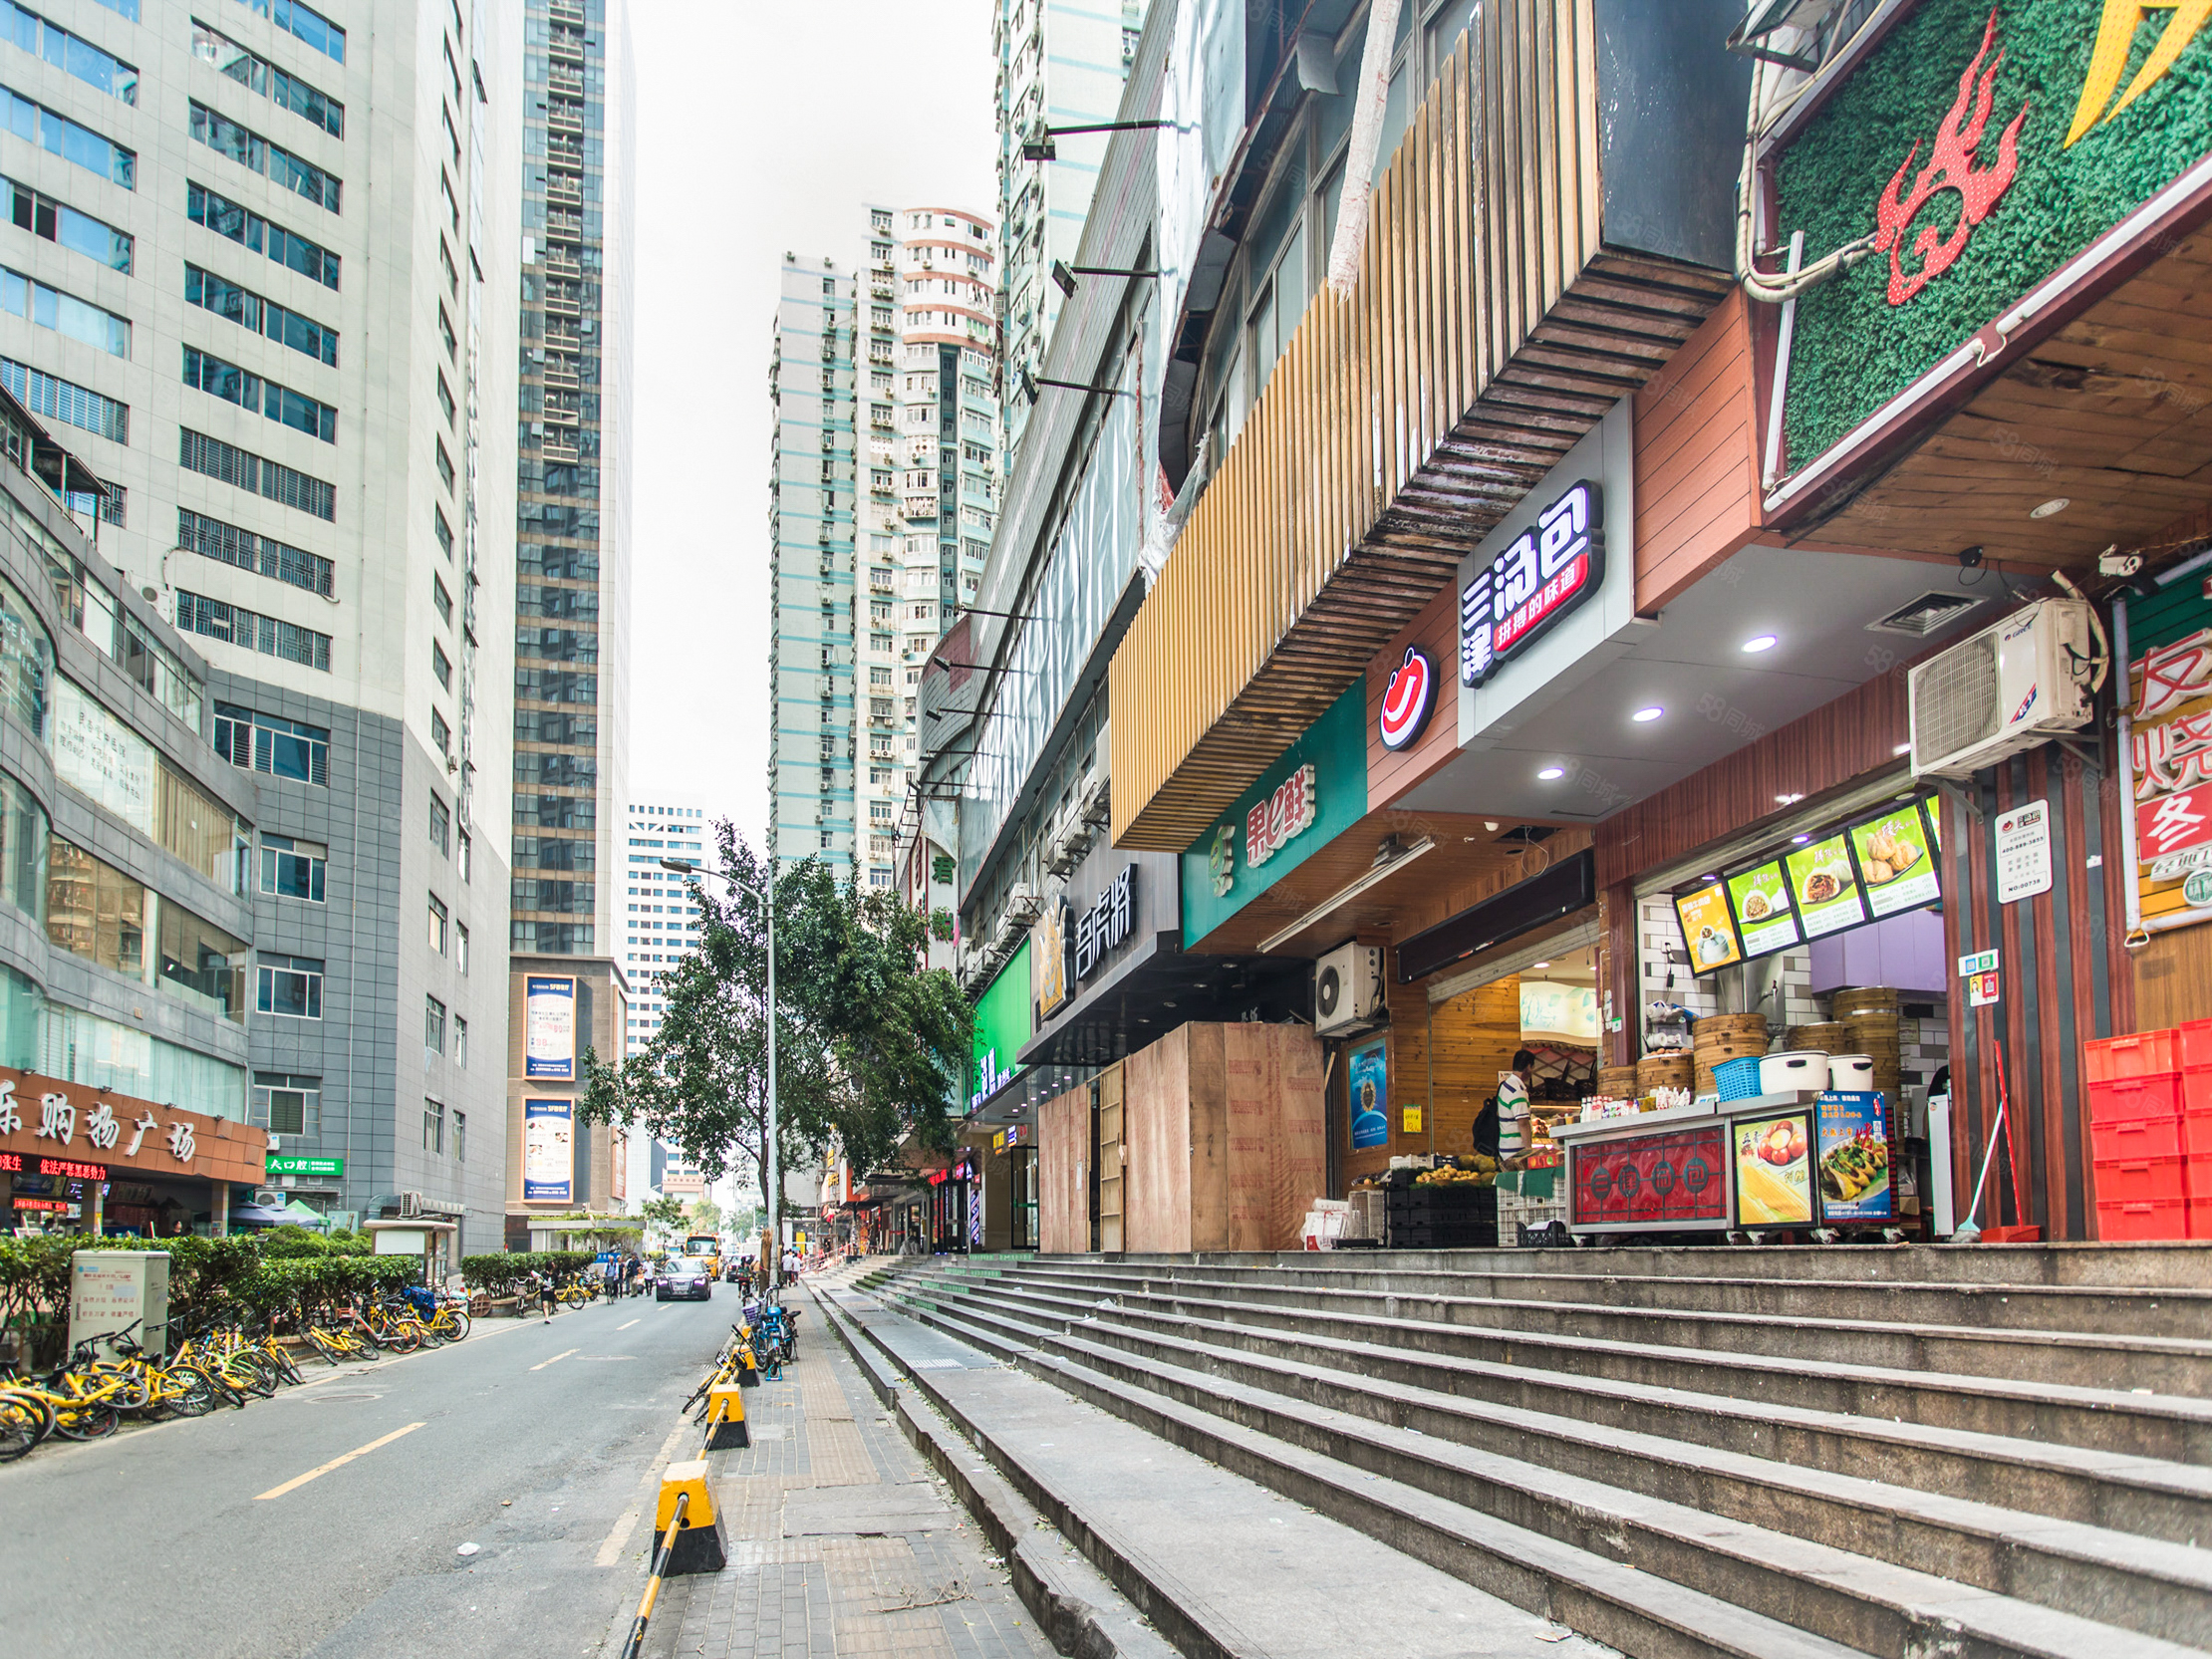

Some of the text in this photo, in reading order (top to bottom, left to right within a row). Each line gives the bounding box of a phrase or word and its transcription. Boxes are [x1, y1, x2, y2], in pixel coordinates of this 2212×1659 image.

[1498, 563, 1577, 647] 拼搏的味道
[1246, 763, 1310, 869] 果e鲜
[2146, 795, 2206, 853] 冬
[39, 1158, 107, 1182] 依法严惩黑恶势力
[265, 1159, 308, 1171] 大口腔
